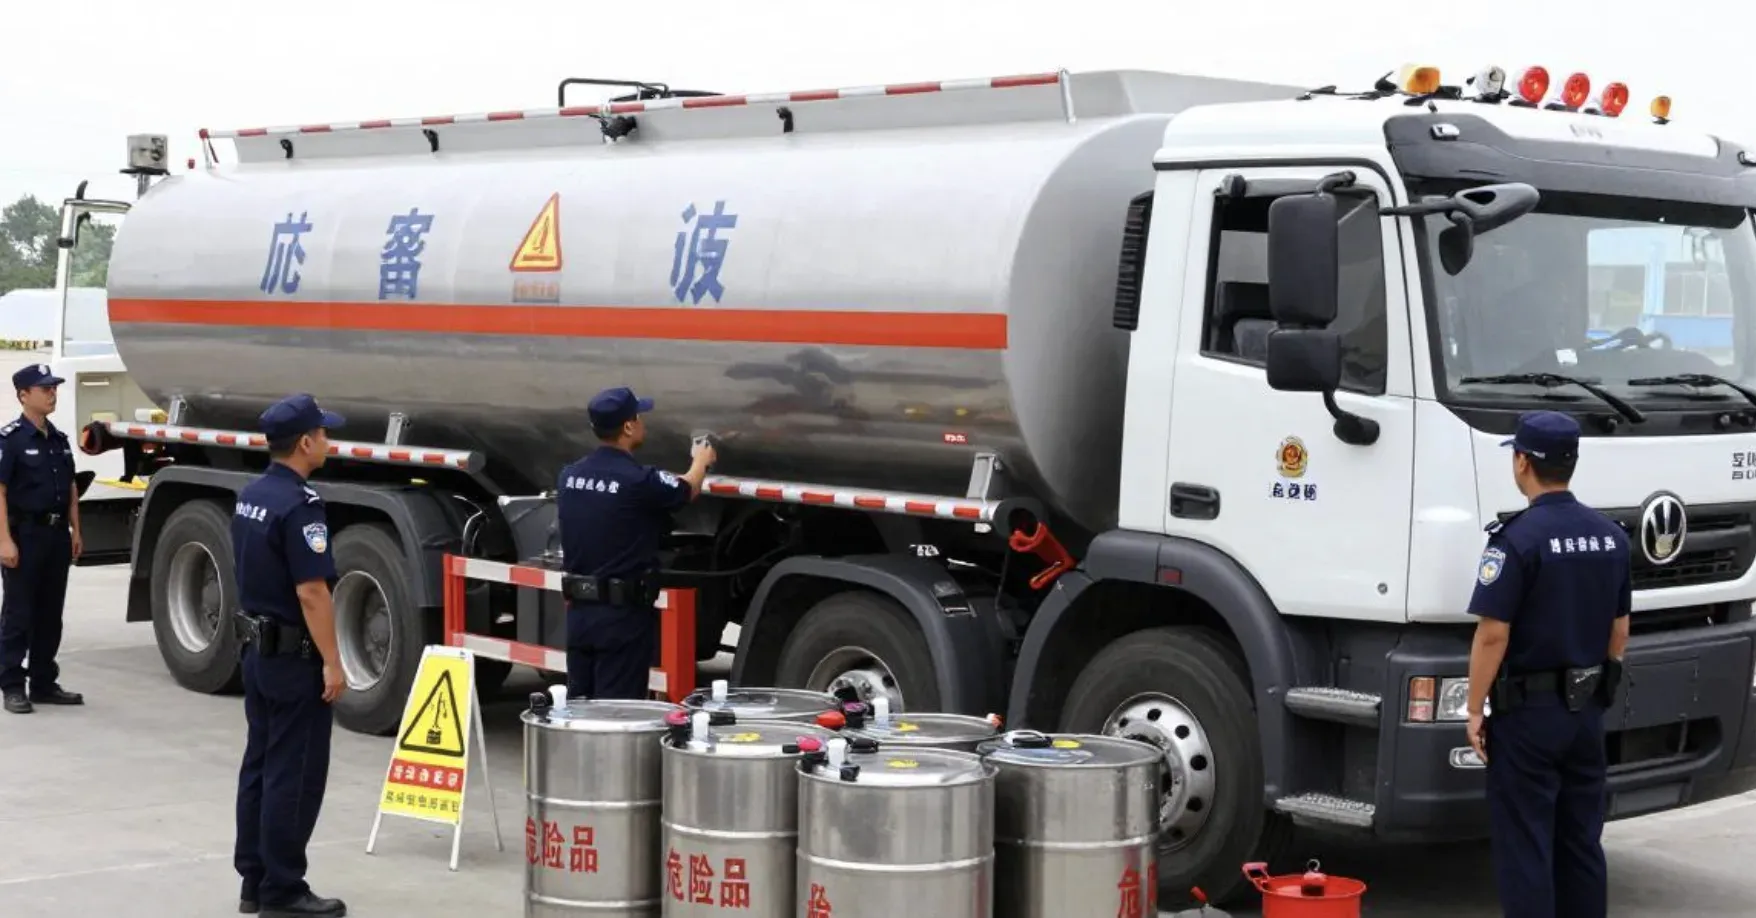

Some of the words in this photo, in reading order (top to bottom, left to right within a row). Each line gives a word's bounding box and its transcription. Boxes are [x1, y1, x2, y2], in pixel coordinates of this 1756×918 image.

[525, 815, 598, 873] 危险品
[666, 847, 750, 908] 危险品
